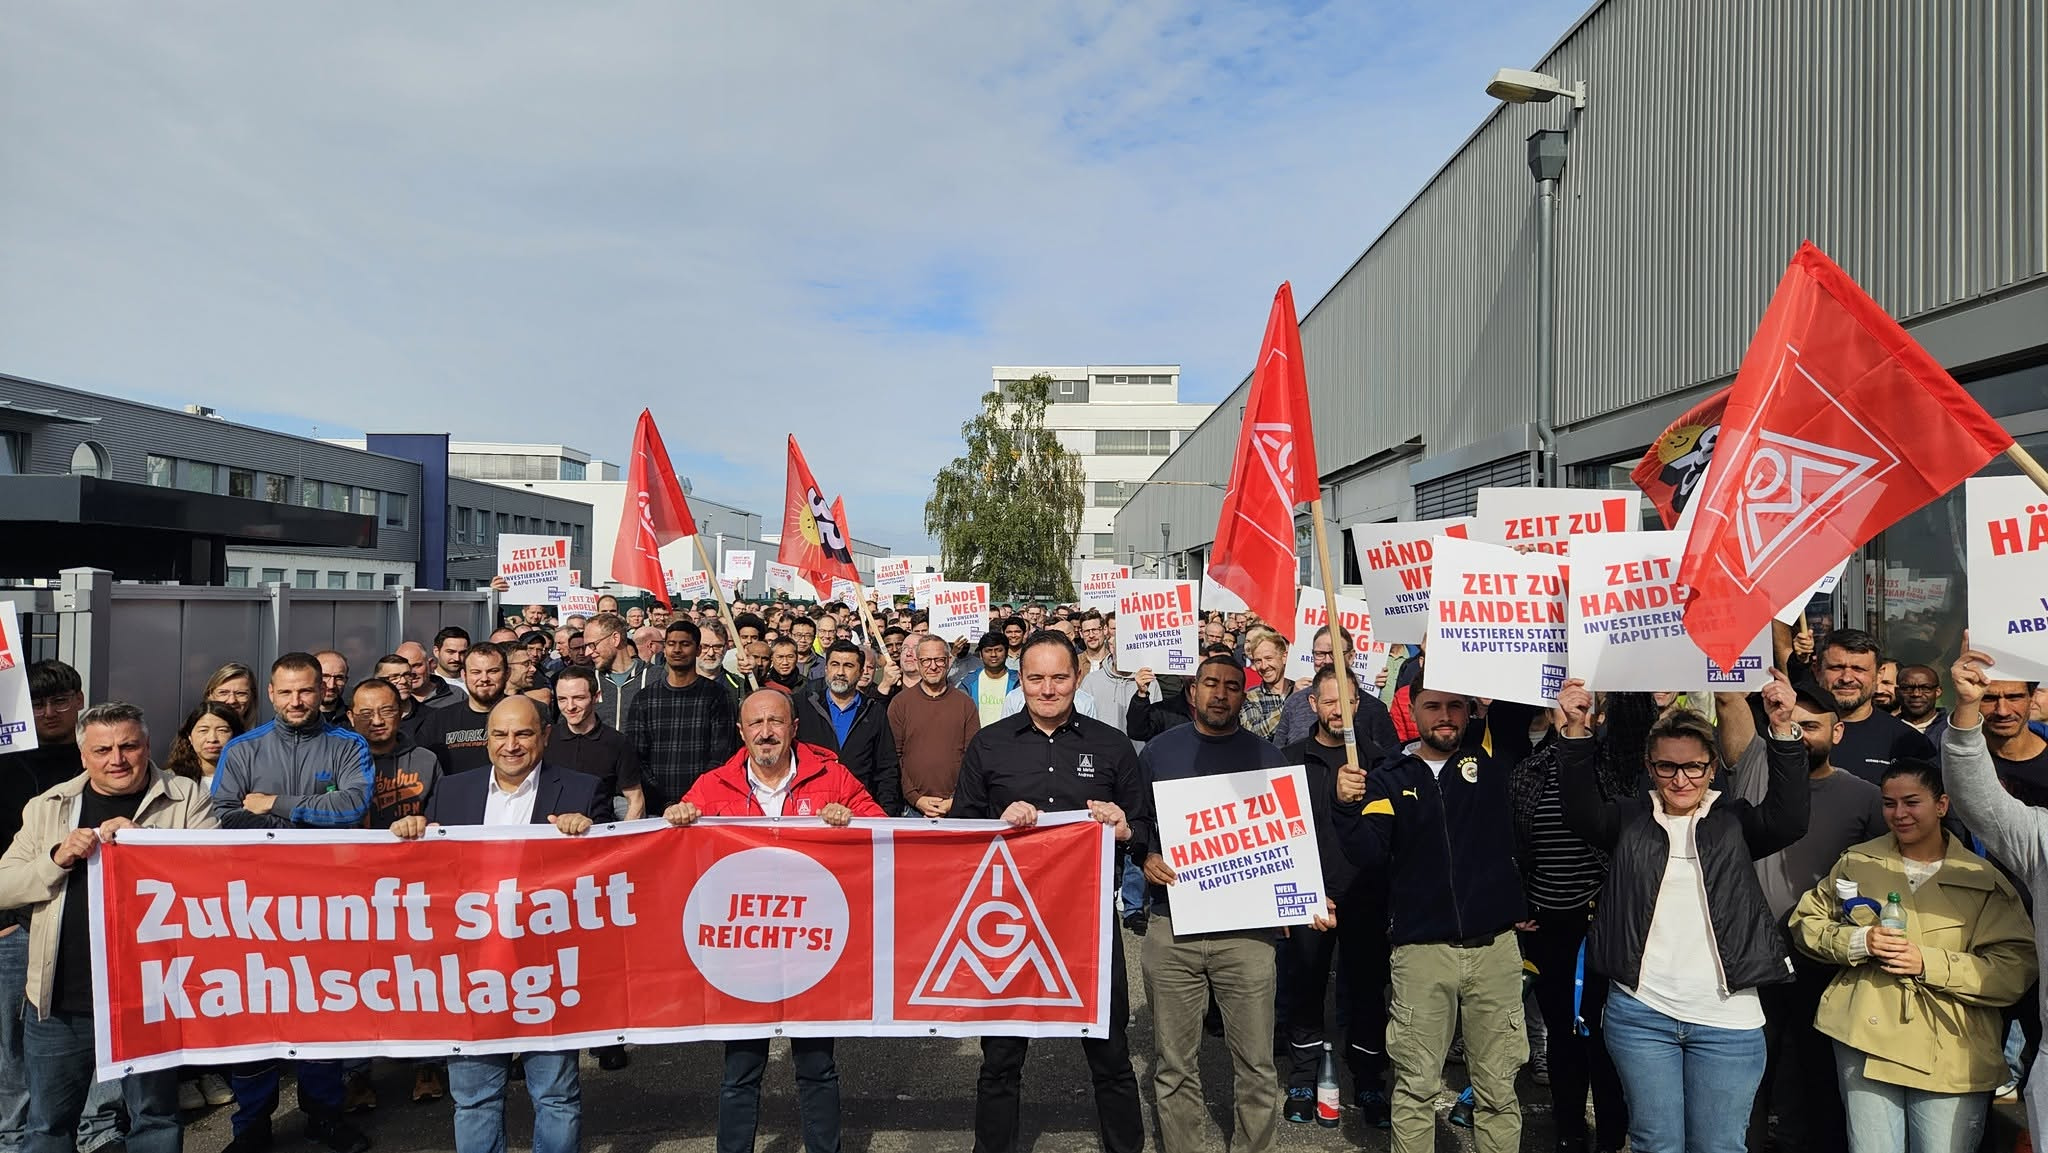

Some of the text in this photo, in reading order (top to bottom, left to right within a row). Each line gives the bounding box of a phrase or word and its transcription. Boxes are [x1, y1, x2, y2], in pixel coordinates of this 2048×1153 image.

[1505, 516, 1560, 540] ZEIT
[1569, 512, 1602, 535] ZU
[1988, 503, 2048, 556] HÄ
[512, 548, 537, 560] ZEIT
[541, 546, 555, 557] ZU
[1367, 540, 1433, 570] HÄND
[1091, 573, 1108, 581] ZEIT
[1605, 558, 1671, 586] ZEIT
[1084, 581, 1116, 590] HANDEL
[1462, 573, 1560, 596] ZEIT ZU
[935, 590, 976, 605] HÄNDE
[1121, 591, 1177, 615] HÄNDE
[1396, 593, 1414, 603] VON
[1580, 584, 1687, 618] HANDE
[1583, 610, 1682, 634] INVESTIEREN
[1135, 629, 1181, 641] VON UNSEREN
[1441, 628, 1566, 639] INVESTIEREN STATT
[1126, 637, 1183, 650] ARBEITSPLÄTZEN!
[1462, 641, 1568, 653] KAPUTTSPAREN!
[1544, 666, 1564, 677] WEIL
[1735, 658, 1759, 668] ETZT
[1543, 678, 1560, 687] DAS
[446, 729, 487, 745] WORK
[1185, 802, 1238, 836] ZEIT
[1244, 792, 1277, 820] ZU
[1177, 845, 1290, 883] INVESTIEREN STATT
[1199, 858, 1295, 891] KAPUTTSPAREN!
[1275, 884, 1296, 894] WEIL
[136, 872, 637, 944] Zukunft statt
[727, 893, 808, 922] JETZT
[1277, 894, 1316, 905] DAS JETZT
[698, 923, 833, 951] REICHT'S!
[140, 946, 581, 1025] Kahlschlag!
